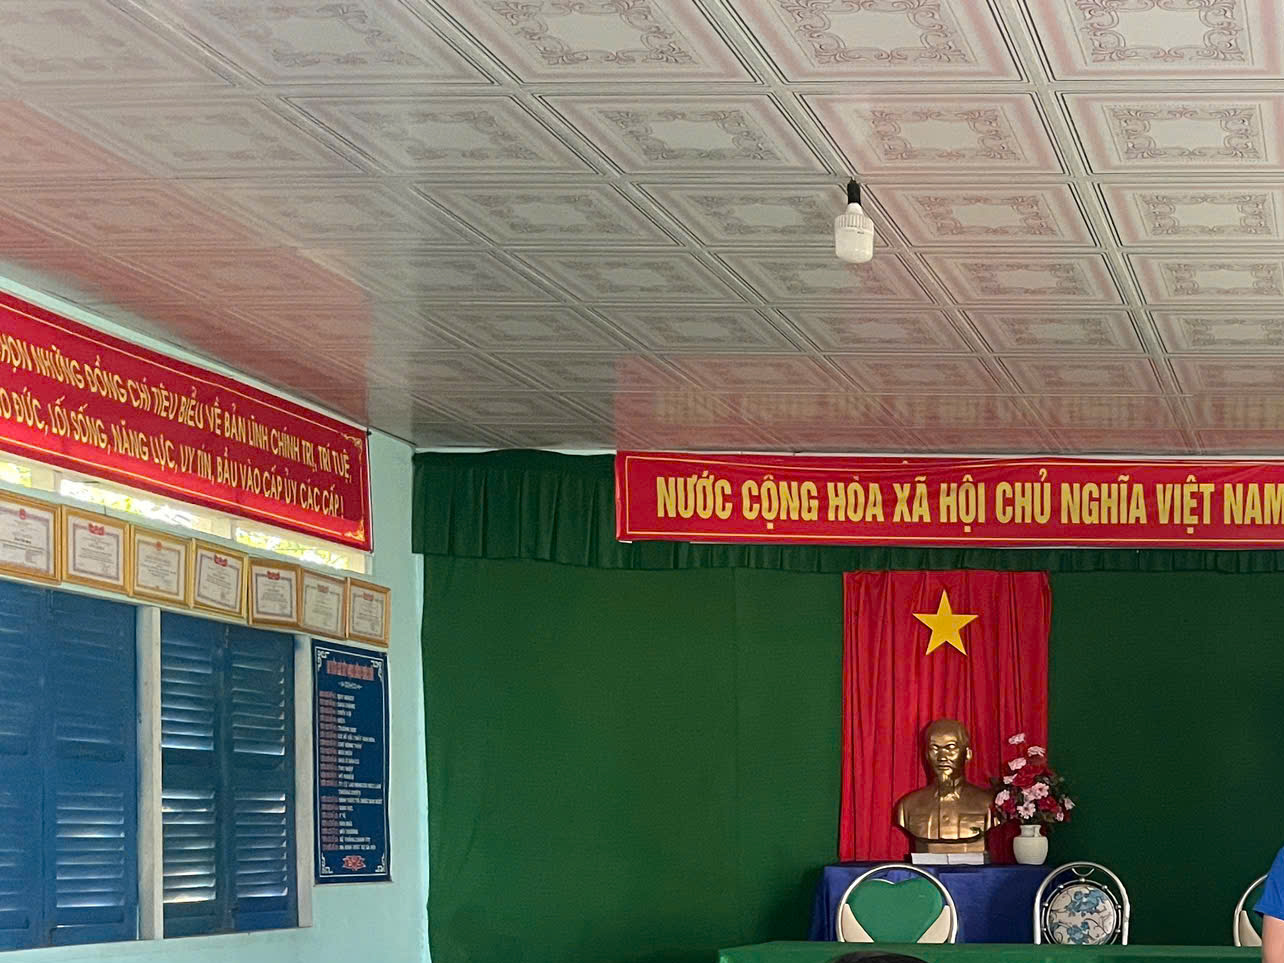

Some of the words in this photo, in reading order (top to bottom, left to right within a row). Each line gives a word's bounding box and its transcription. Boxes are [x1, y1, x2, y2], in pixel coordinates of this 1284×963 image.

[0, 332, 32, 373] HỌN
[31, 344, 85, 389] NHỮNG
[84, 355, 127, 403] ĐỒNG
[127, 377, 151, 412] CHÍ
[151, 382, 178, 420] TIÊU
[178, 386, 204, 430] BIỂU
[205, 396, 222, 436] VỀ
[224, 402, 246, 444] BẢN
[247, 414, 269, 452] LĨNH
[271, 426, 300, 463] CHÍNH
[301, 439, 318, 473] TRỊ,
[318, 443, 332, 473] TRÍ
[332, 448, 352, 484] TUỆ,
[12, 386, 48, 436] ĐỨC,
[48, 395, 71, 438] LỐI
[71, 403, 111, 456] SỐNG,
[112, 420, 149, 461] NĂNG
[150, 433, 178, 473] LỰC,
[180, 443, 196, 474] UY
[197, 443, 215, 486] TÍN,
[217, 446, 239, 488] BẦU
[240, 458, 261, 496] VÀO
[262, 464, 283, 501] CẤP
[284, 467, 297, 506] ỦY
[300, 478, 320, 513] CÁC
[656, 470, 733, 520] NƯỚC
[741, 474, 819, 530] CỘNG
[826, 475, 885, 522] HÒA
[892, 476, 931, 522] XÃ
[939, 474, 985, 533] HỘI
[995, 468, 1051, 524] CHỦ
[1060, 474, 1148, 525] NGHĨA
[1156, 474, 1216, 534] VIỆT
